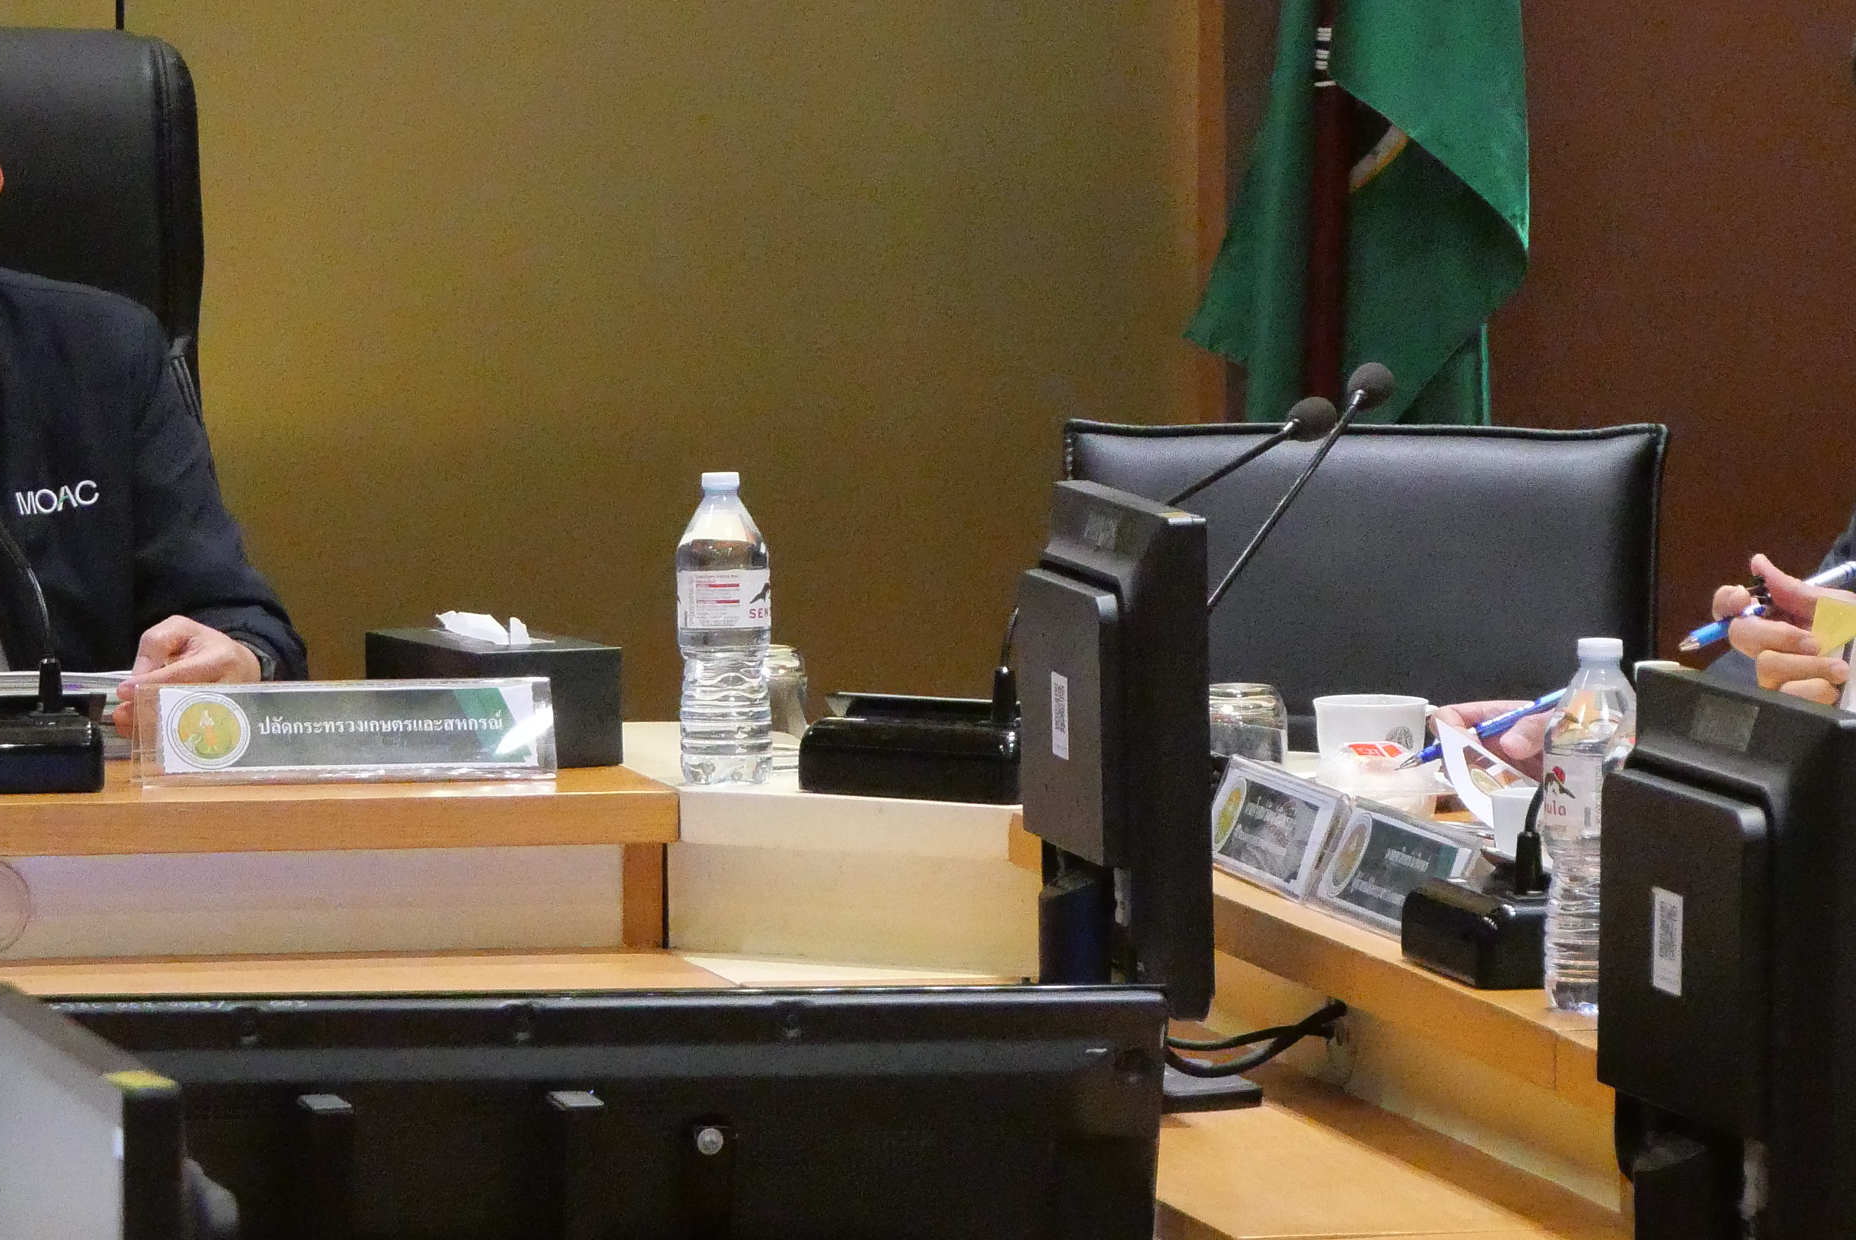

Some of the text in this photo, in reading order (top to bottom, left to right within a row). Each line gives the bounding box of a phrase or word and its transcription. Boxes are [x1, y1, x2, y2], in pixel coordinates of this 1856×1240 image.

[15, 480, 100, 515] MOAC
[749, 608, 771, 619] SEN
[257, 709, 504, 736] ปลัดกระทรวงเกษตรและสหกรณ์
